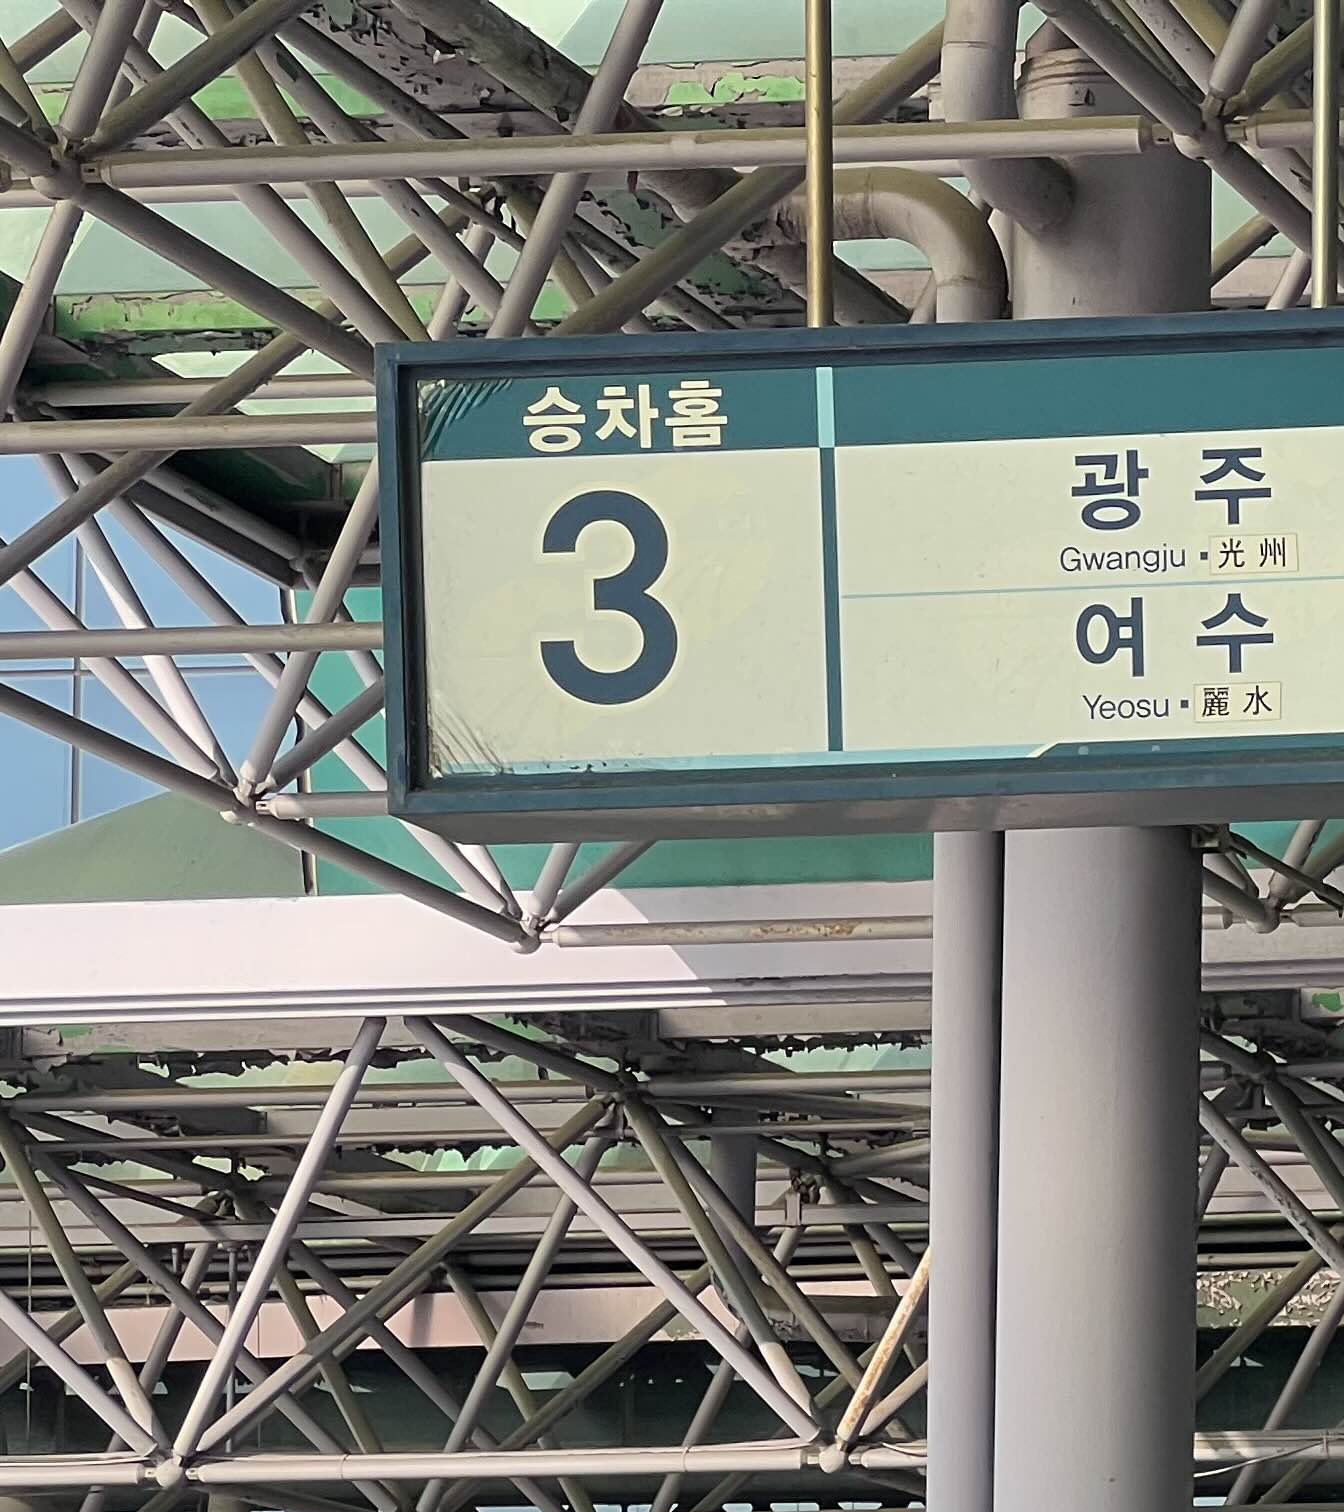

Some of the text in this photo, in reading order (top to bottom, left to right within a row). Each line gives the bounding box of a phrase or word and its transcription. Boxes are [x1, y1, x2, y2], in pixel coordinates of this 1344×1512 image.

[522, 378, 729, 454] 승차홈
[1060, 543, 1186, 572] Gwangju
[540, 489, 679, 705] 3
[1082, 695, 1169, 719] Yeosu
